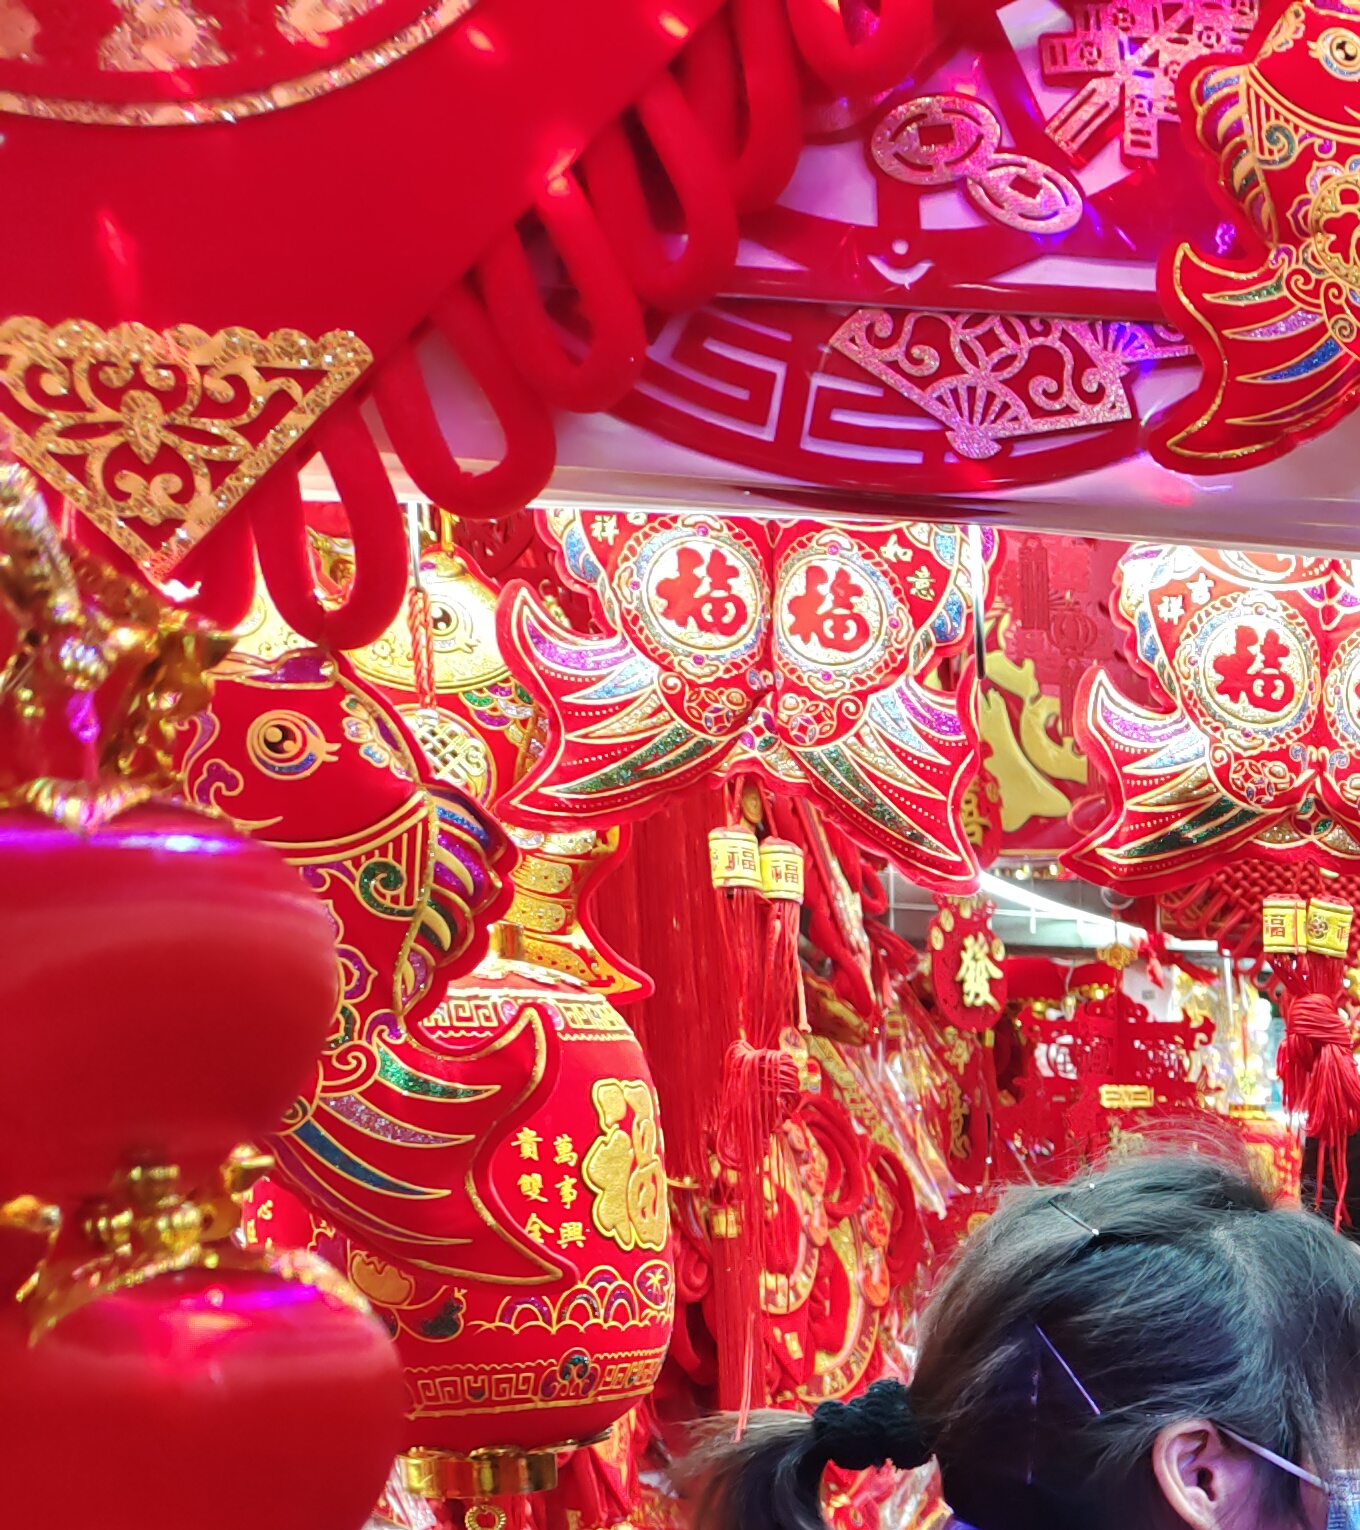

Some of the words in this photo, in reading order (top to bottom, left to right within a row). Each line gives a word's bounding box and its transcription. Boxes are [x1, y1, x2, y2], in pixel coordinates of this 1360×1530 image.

[656, 547, 746, 636] 福
[788, 565, 870, 653] 福
[880, 534, 937, 602] 如意
[1158, 572, 1215, 625] 吉祥
[1213, 625, 1294, 712] 福
[726, 846, 757, 872] 福
[771, 860, 799, 885] 福
[511, 1126, 554, 1245] 貴雙全
[553, 1133, 586, 1250] 萬事興
[581, 1078, 668, 1252] 福
